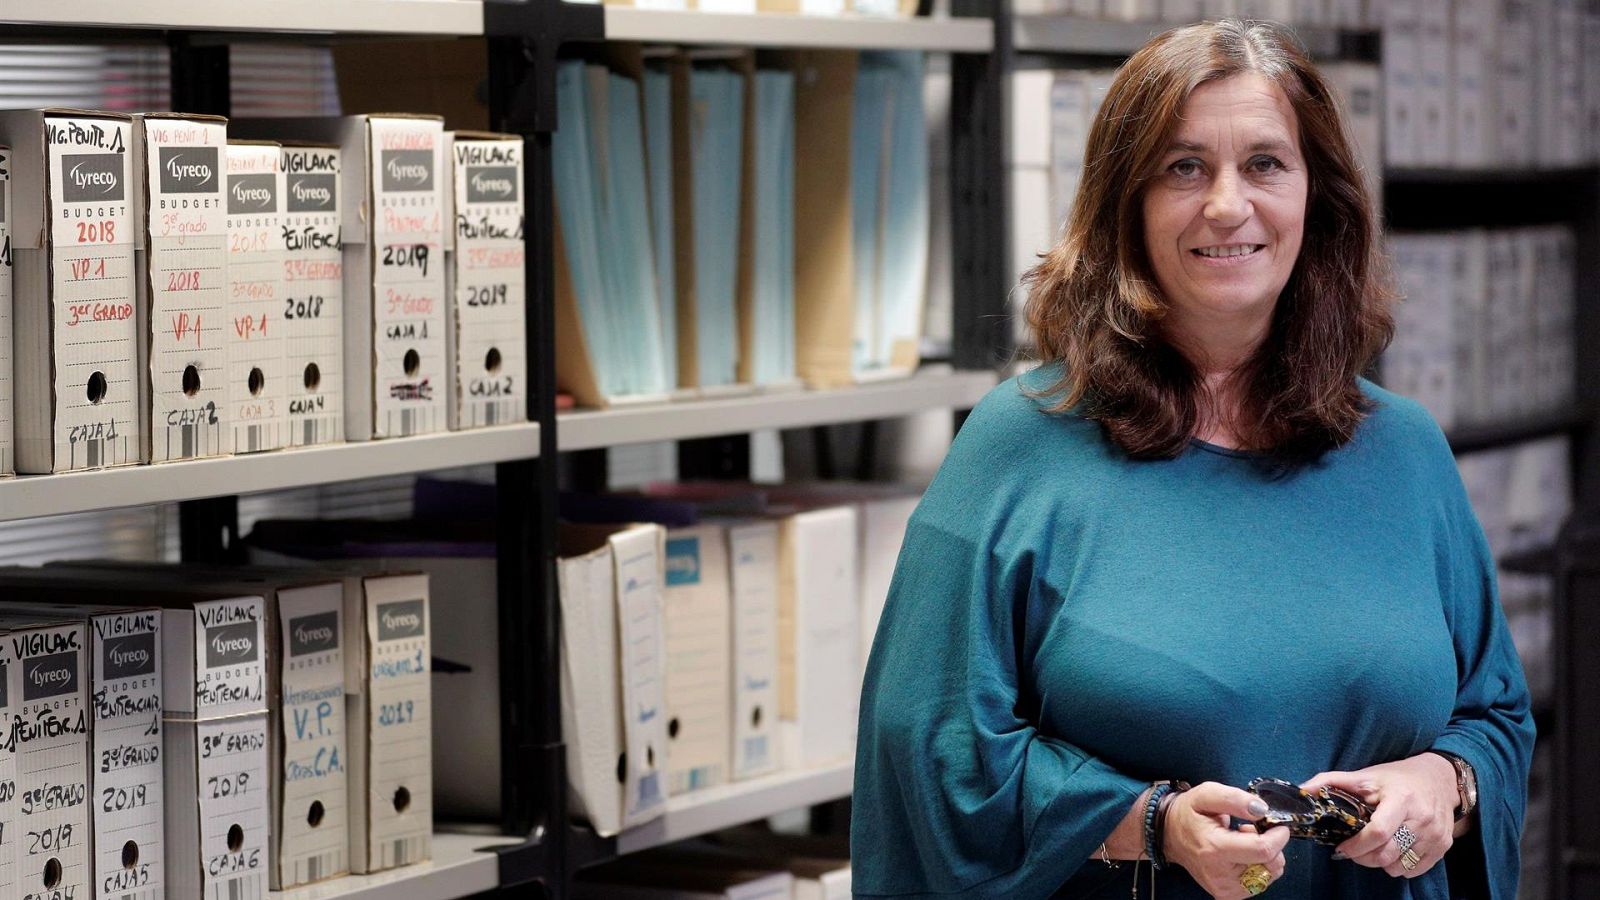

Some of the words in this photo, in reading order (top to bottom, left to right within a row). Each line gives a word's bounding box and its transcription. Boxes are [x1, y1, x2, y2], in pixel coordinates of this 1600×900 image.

[109, 126, 126, 153] 1
[75, 170, 115, 190] Lyreco
[172, 161, 209, 181] Lyreco
[391, 161, 425, 182] Lyreco
[477, 173, 510, 195] Lyreco
[160, 199, 220, 209] BUDGET
[237, 187, 269, 204] Lyreco
[297, 187, 328, 203] Lyreco
[63, 207, 125, 219] BUDGET
[227, 218, 278, 228] BUDGET
[286, 217, 337, 226] BUDGET
[77, 220, 115, 243] 2018
[231, 232, 269, 253] 2018
[383, 244, 429, 278] 2019
[168, 271, 200, 291] 2018
[467, 284, 507, 307] 2019
[93, 303, 133, 321] GRADO
[284, 295, 324, 319] 2018
[503, 376, 513, 394] 2
[316, 395, 324, 410] 4
[167, 407, 206, 426] CAJA
[69, 423, 105, 444] CAJA
[385, 613, 418, 631] Lyreco
[300, 626, 331, 645] Lyreco
[216, 638, 249, 656] Lyreco
[114, 649, 147, 667] Lyreco
[34, 668, 69, 688] Lyreco
[206, 665, 259, 682] BUDGET
[103, 678, 156, 693] BUDGET
[23, 698, 78, 715] BUDGET
[379, 700, 414, 727] 2019
[122, 746, 159, 767] GRADO
[208, 772, 250, 799] 2019
[45, 784, 85, 810] GRADO
[103, 784, 147, 813] 2019
[28, 824, 73, 855] 2019
[209, 857, 246, 877] CAJA
[248, 849, 261, 869] 6
[104, 868, 138, 894] CAJA
[140, 864, 150, 886] 5
